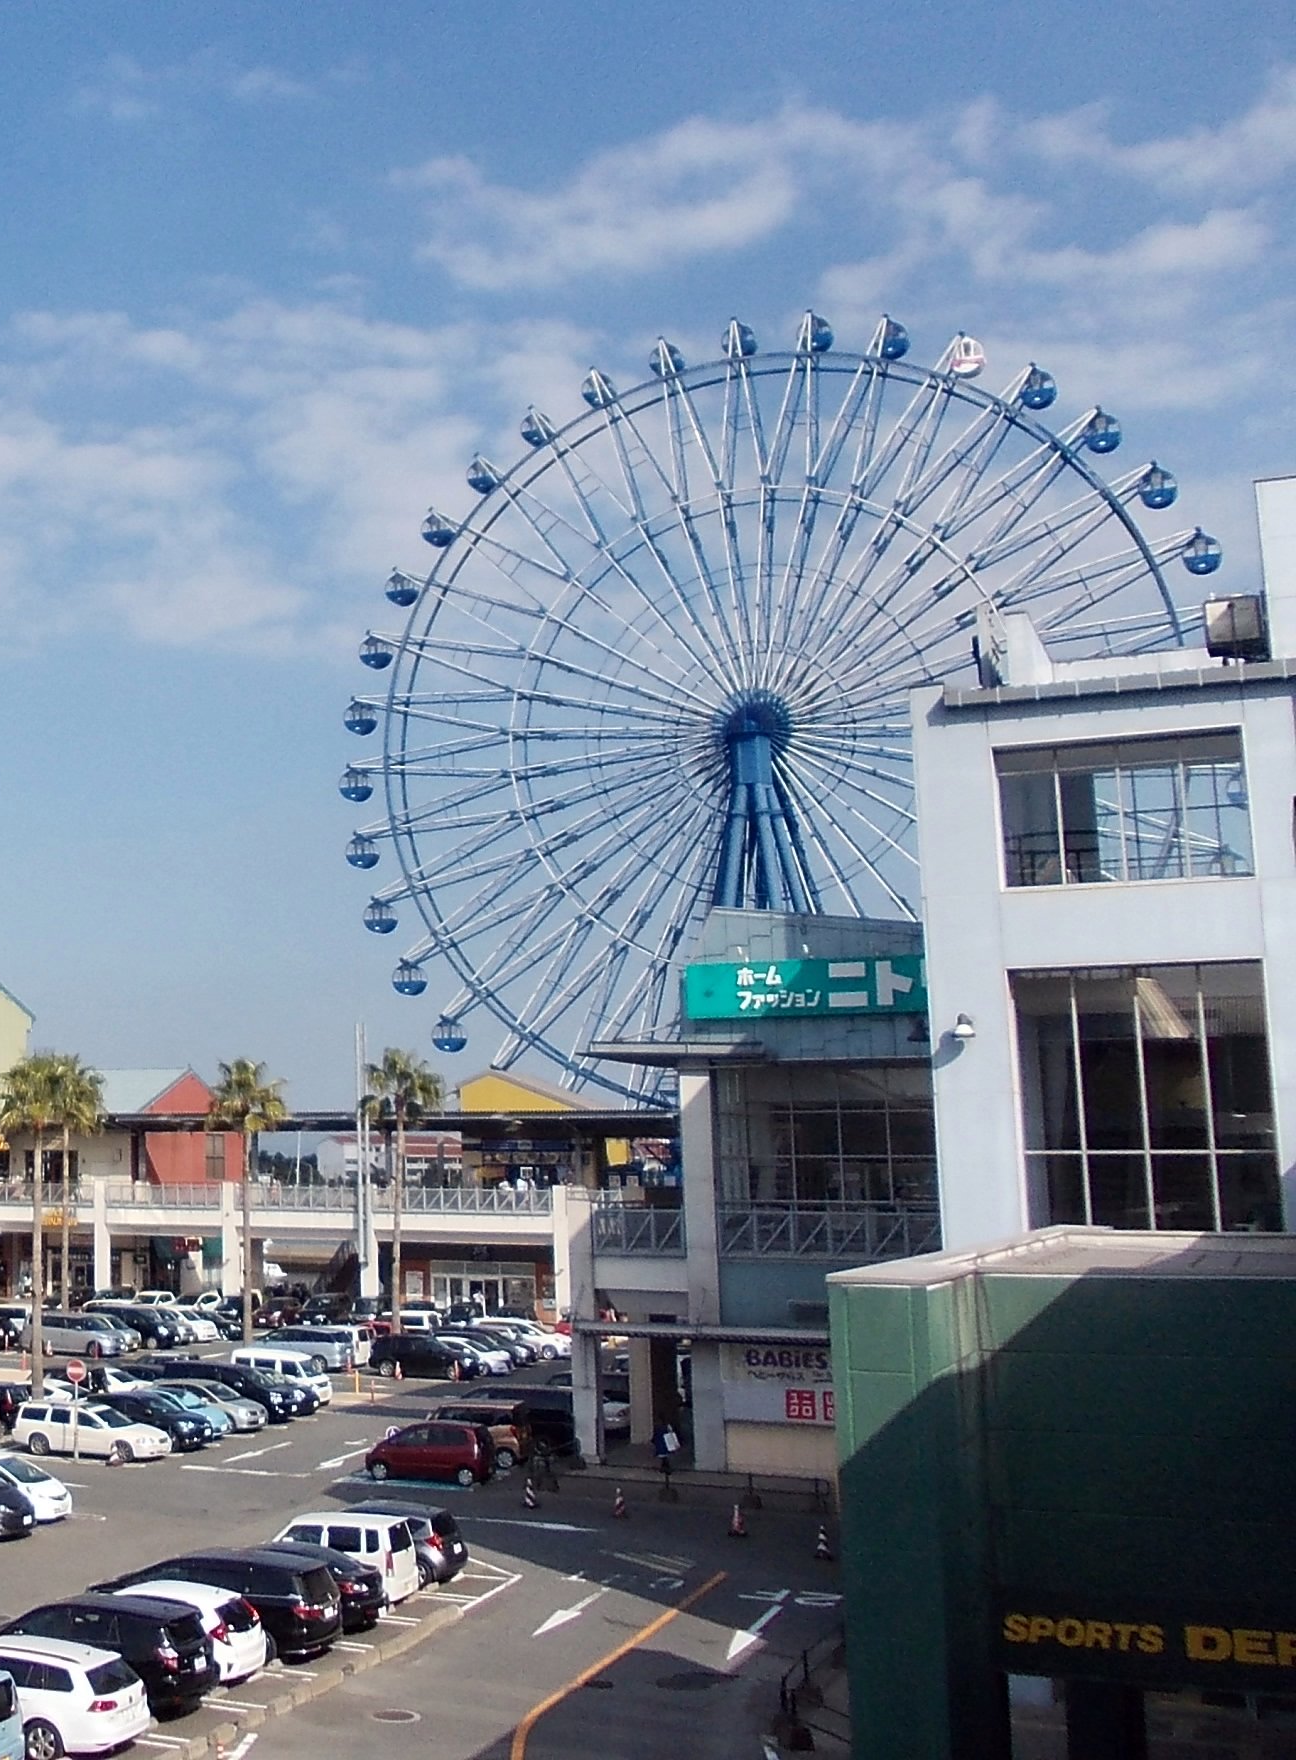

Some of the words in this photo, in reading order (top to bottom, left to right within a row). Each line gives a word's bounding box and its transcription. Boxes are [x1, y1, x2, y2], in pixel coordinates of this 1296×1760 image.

[736, 965, 782, 986] ホーム
[829, 960, 927, 1007] ニト
[736, 990, 821, 1010] ファッション
[1003, 1613, 1165, 1654] SPORTS
